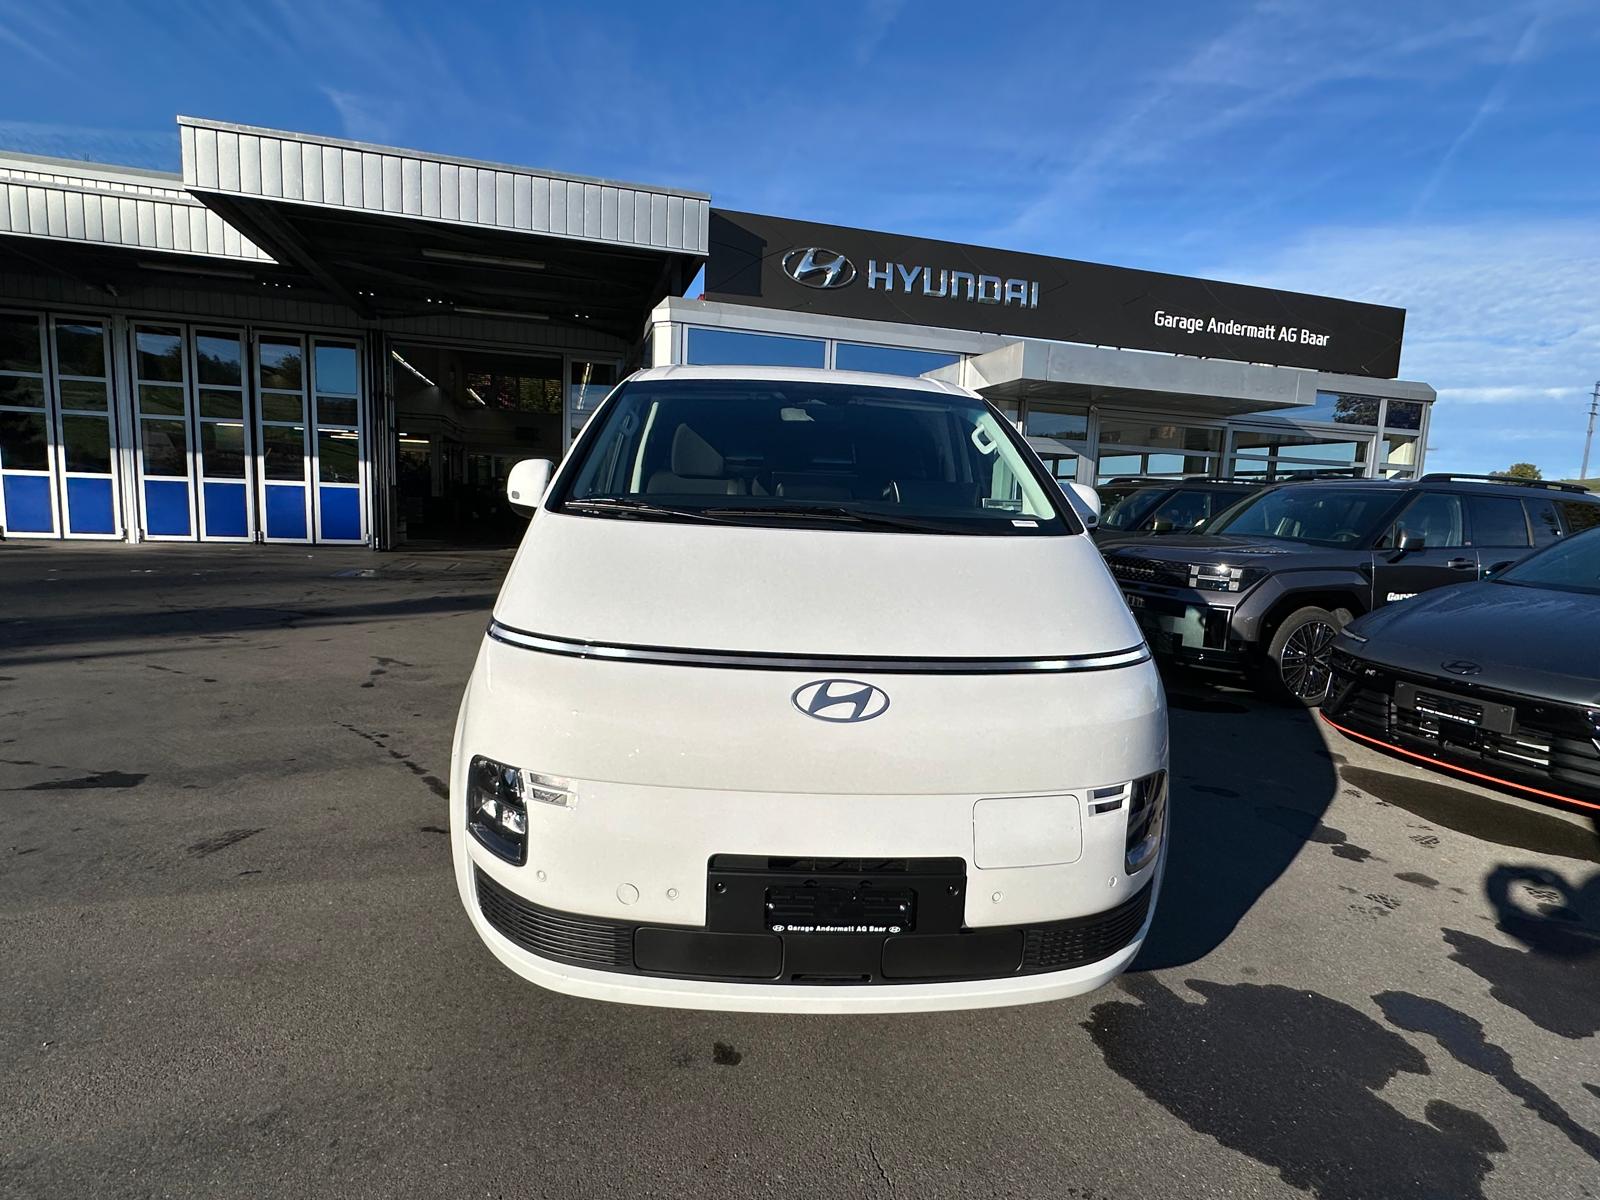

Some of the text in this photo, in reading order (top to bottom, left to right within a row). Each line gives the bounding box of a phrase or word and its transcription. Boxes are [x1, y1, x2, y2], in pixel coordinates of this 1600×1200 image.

[867, 259, 1039, 309] HYUNDAI
[1154, 310, 1330, 346] Garage Andermatt AG Baar
[787, 924, 815, 932] Garage
